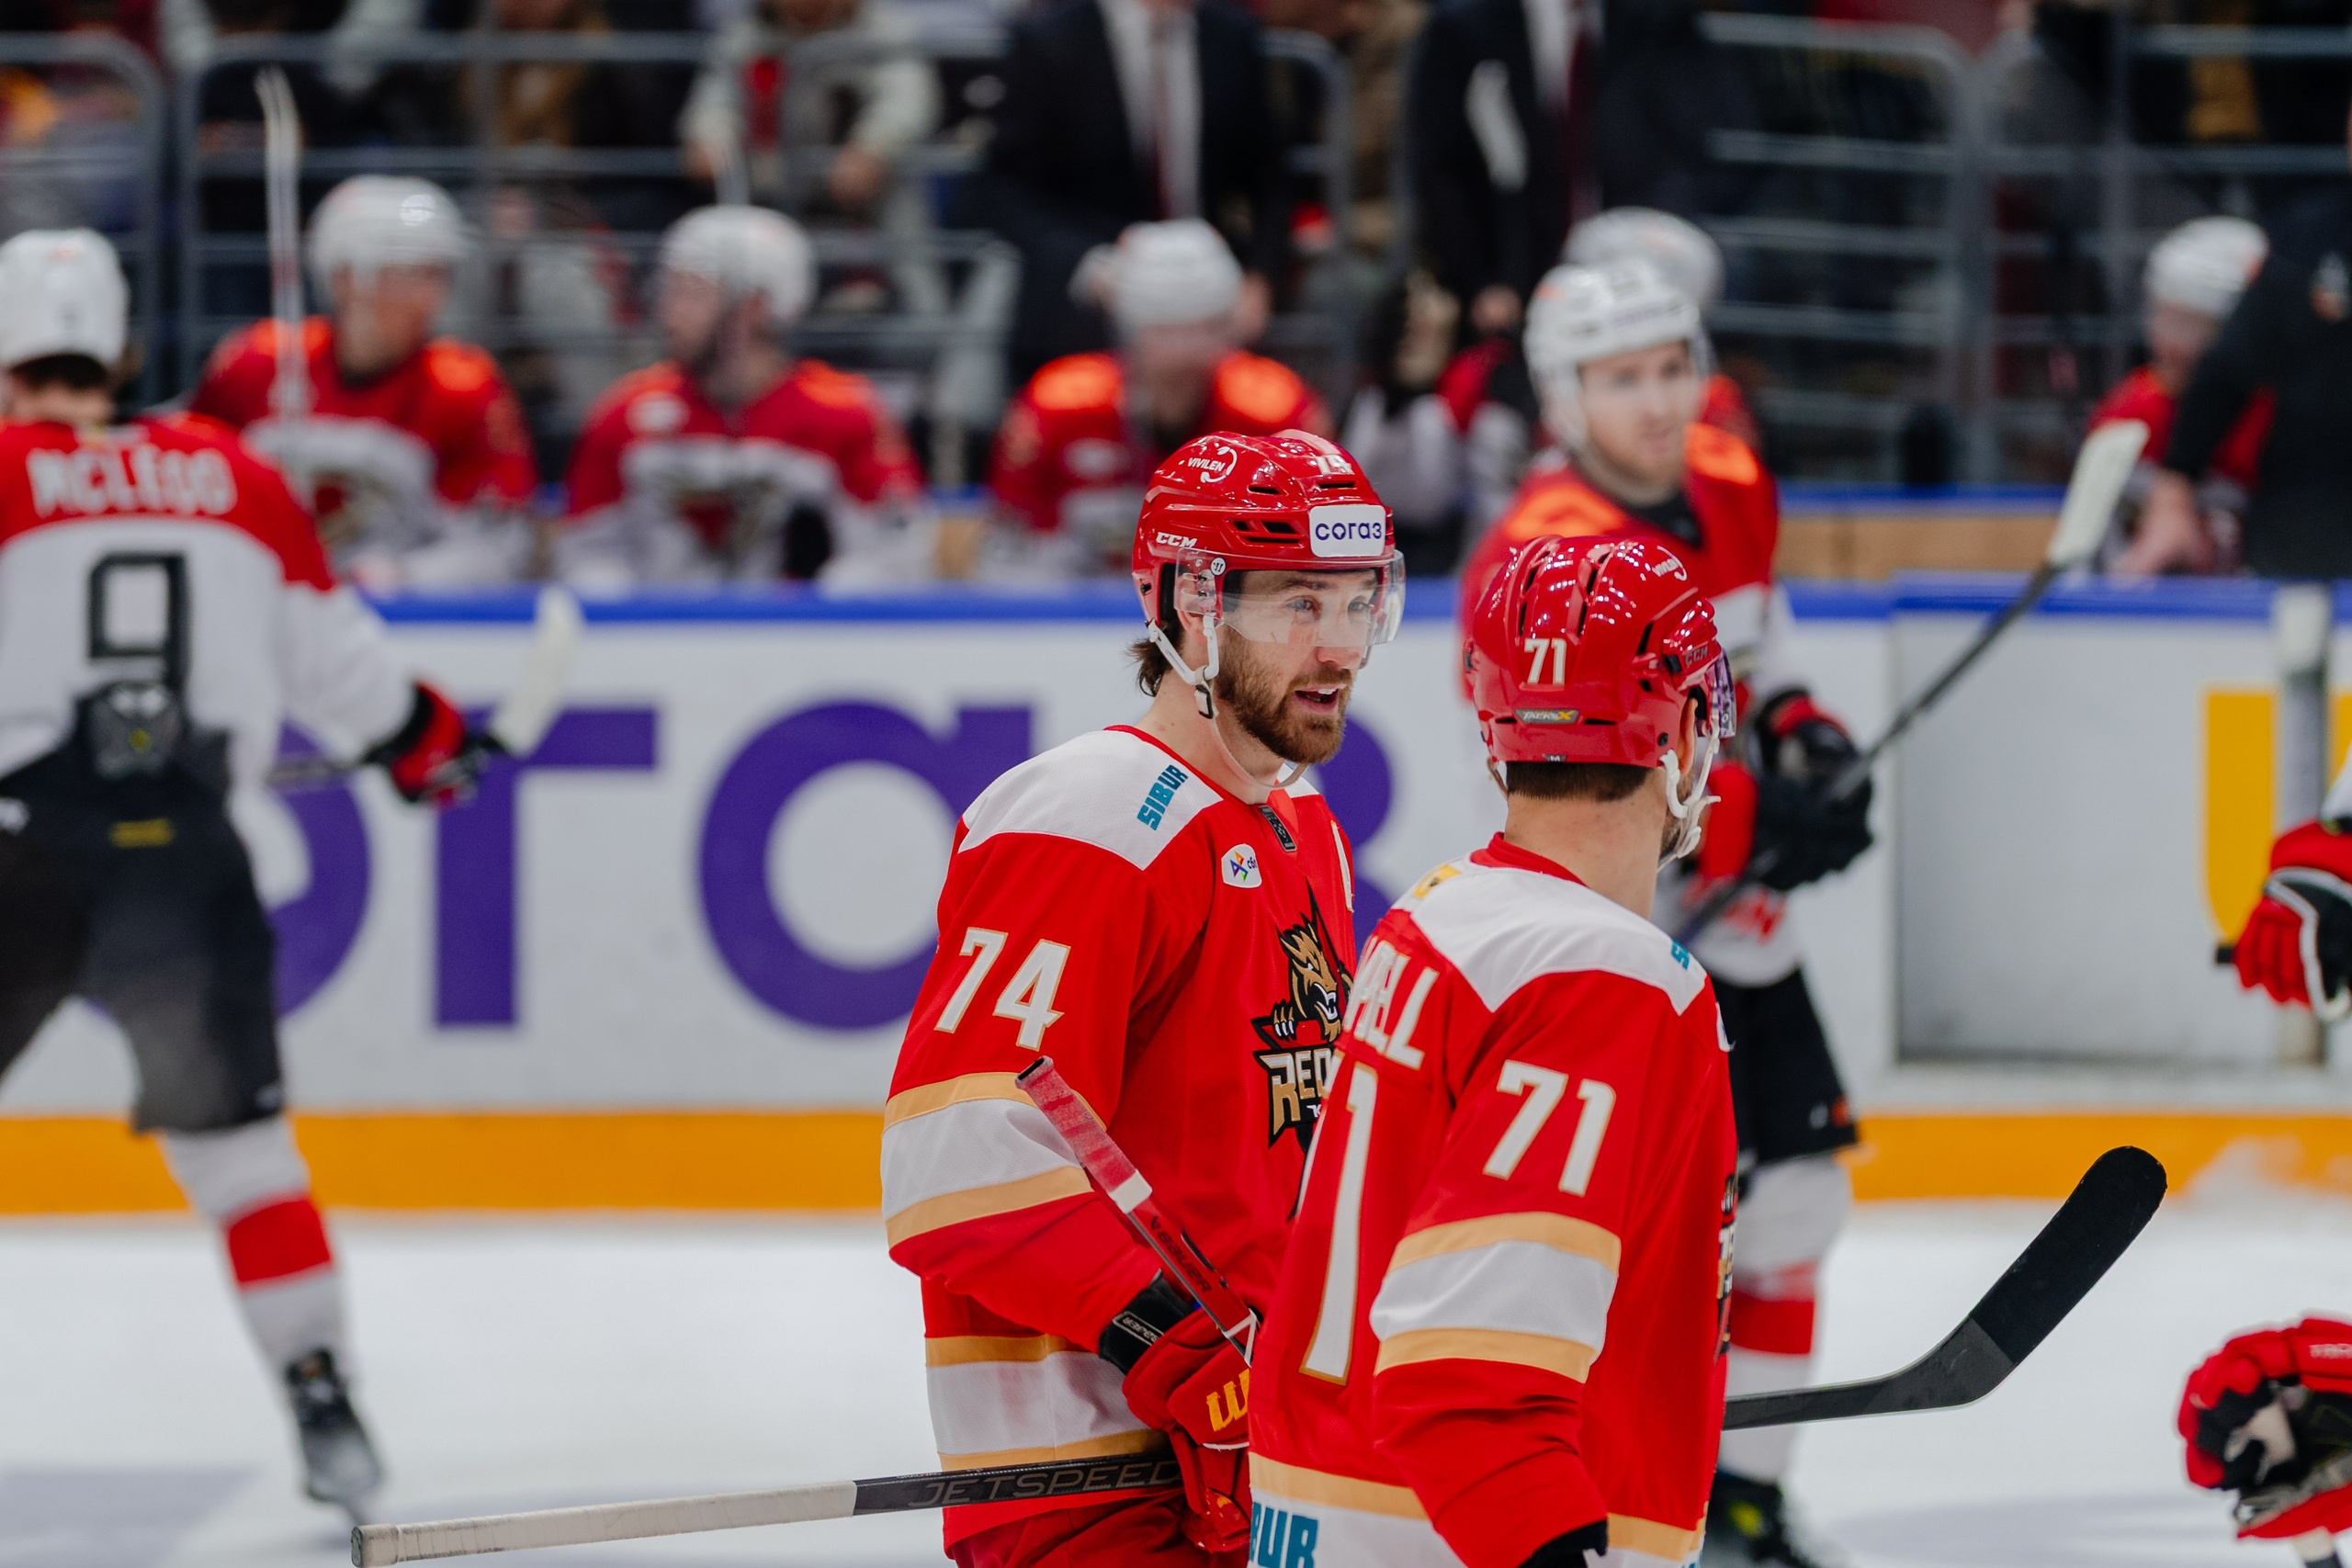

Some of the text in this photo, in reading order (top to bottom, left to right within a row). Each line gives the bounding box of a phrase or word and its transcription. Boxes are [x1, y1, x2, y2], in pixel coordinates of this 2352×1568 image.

[1187, 457, 1227, 472] VIVILEN
[1156, 532, 1197, 548] CCM
[88, 554, 190, 694] 9
[1522, 637, 1567, 685] 71
[1685, 645, 1708, 666] CCM
[1136, 764, 1189, 830] SIBUR
[933, 926, 1071, 1052] 74
[1482, 1059, 1617, 1197] 71
[908, 1459, 1183, 1507] JETSPEED
